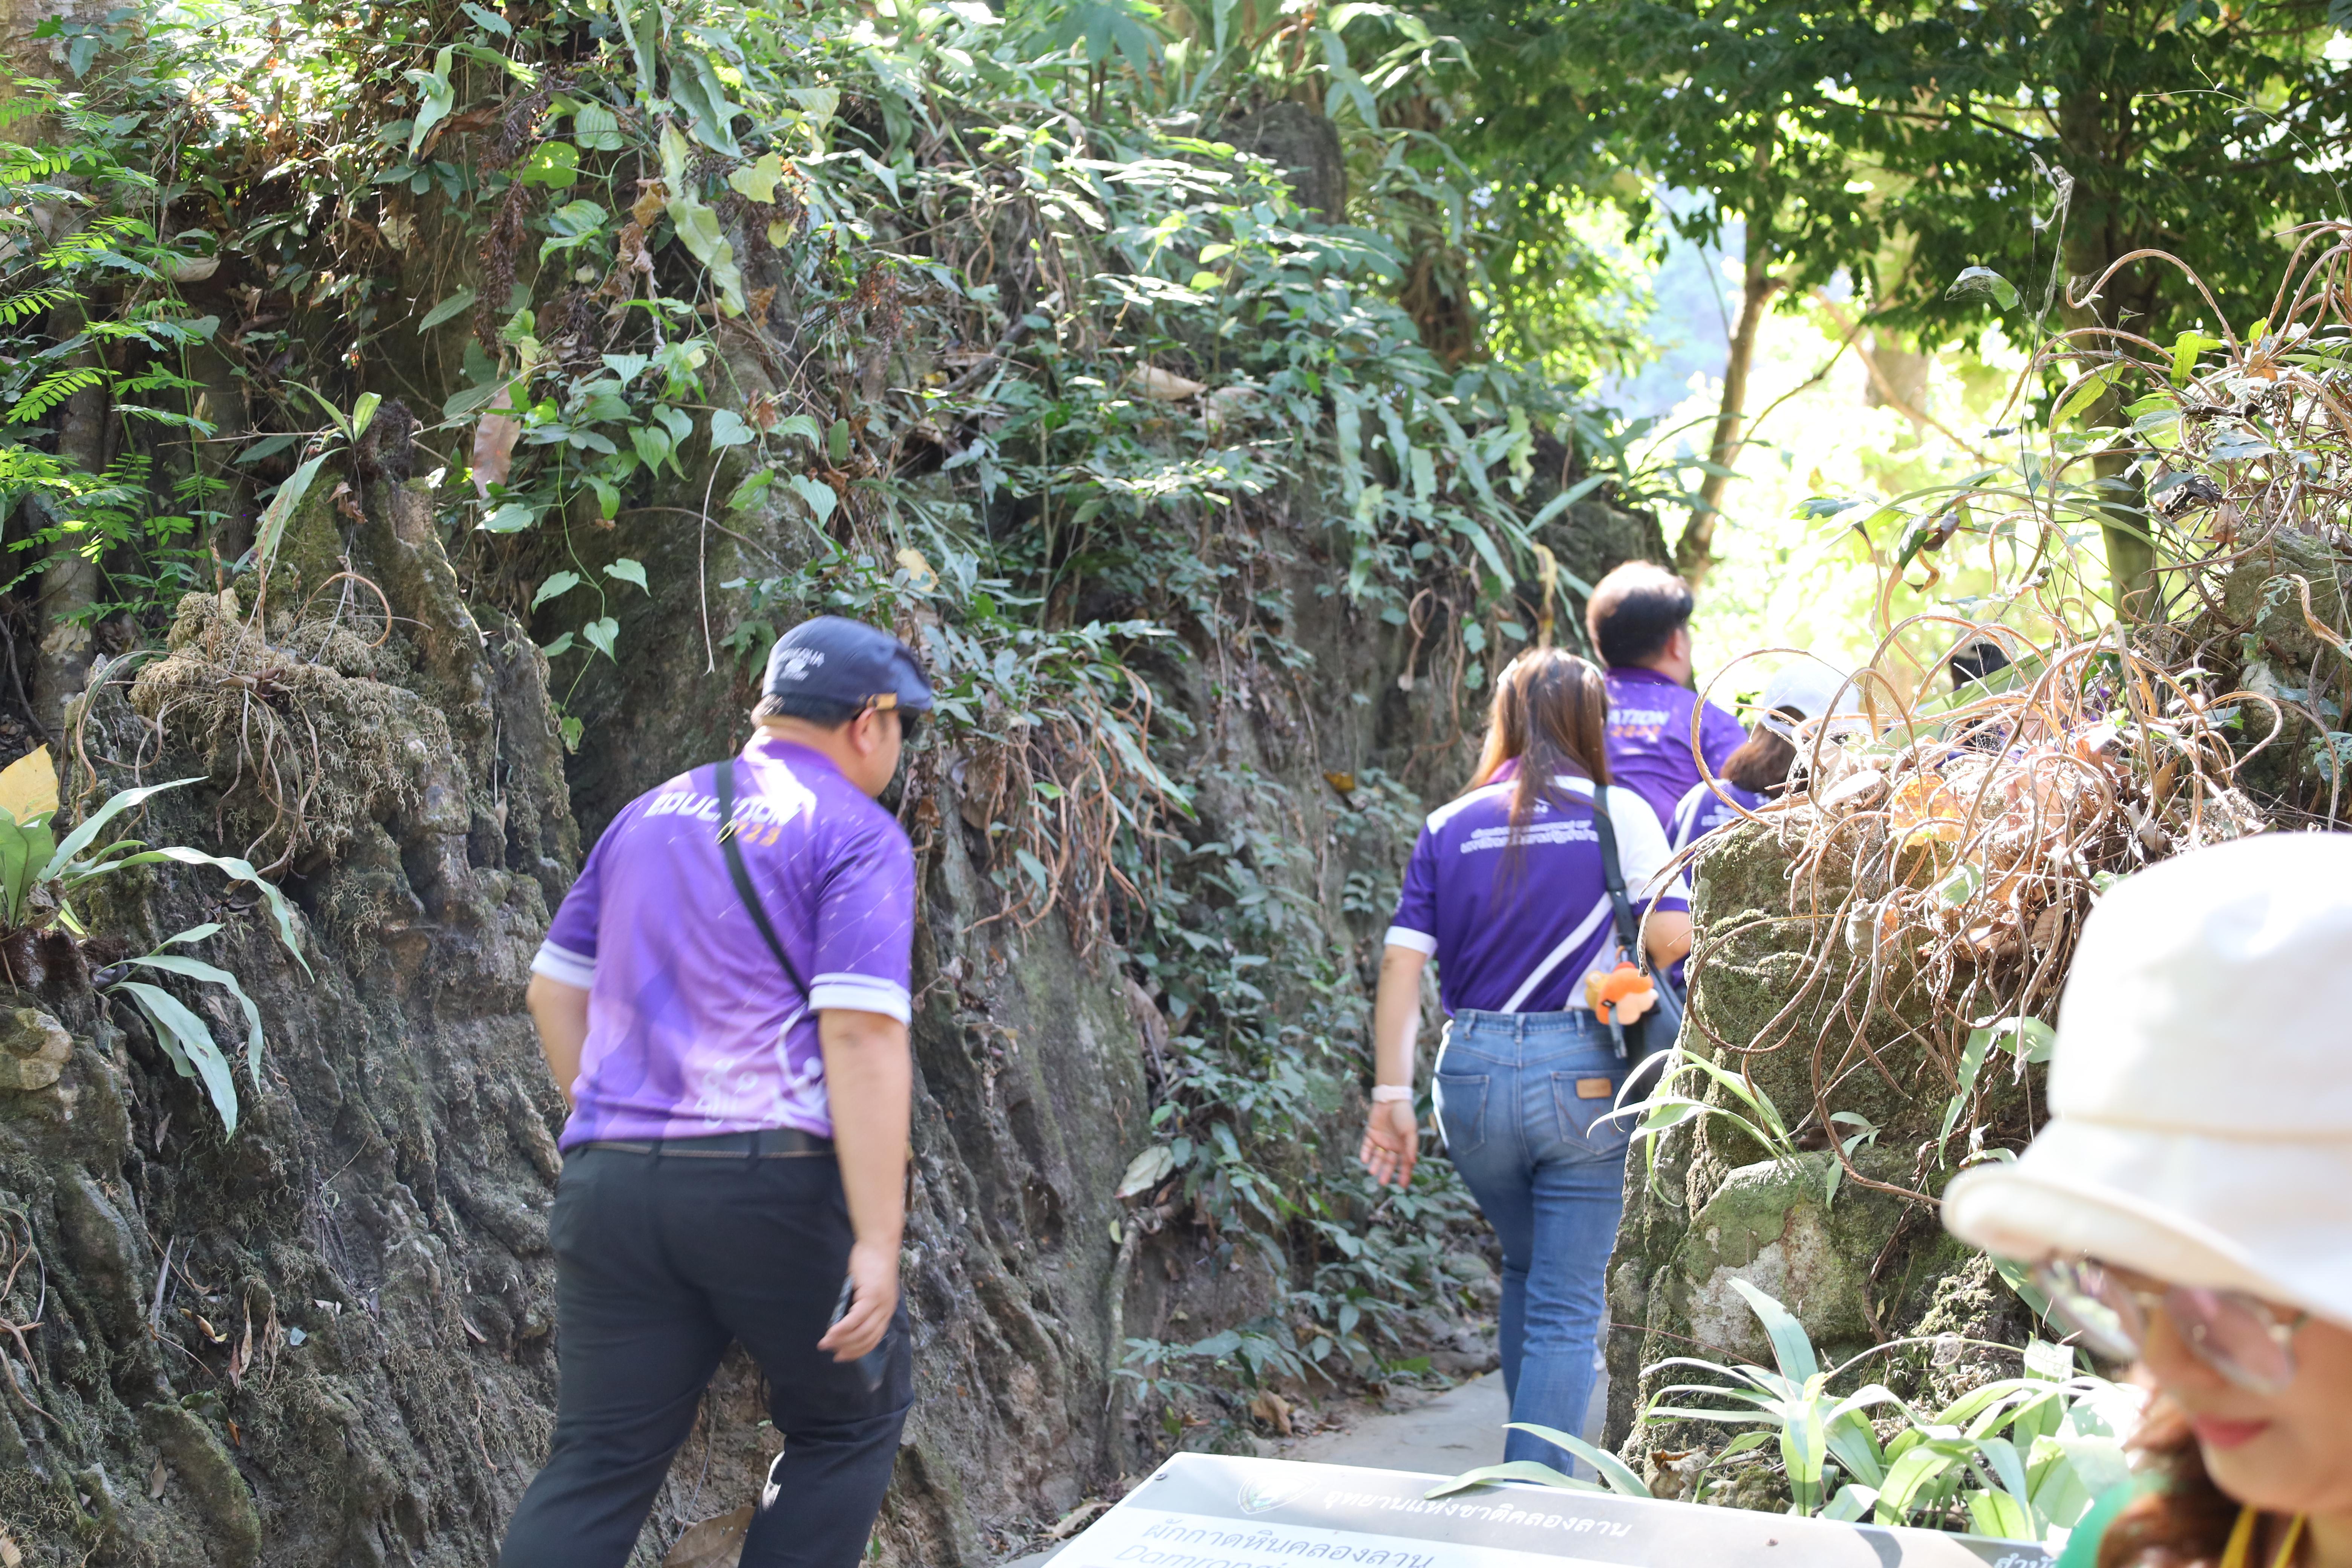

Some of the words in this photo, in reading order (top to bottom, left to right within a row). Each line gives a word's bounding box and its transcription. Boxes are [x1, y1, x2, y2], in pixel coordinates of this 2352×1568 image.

[1323, 1490, 1632, 1537] อุทยานแห่งชาติคลองลาน
[1141, 1518, 1435, 1568] ผักกาดหินคลองลาน
